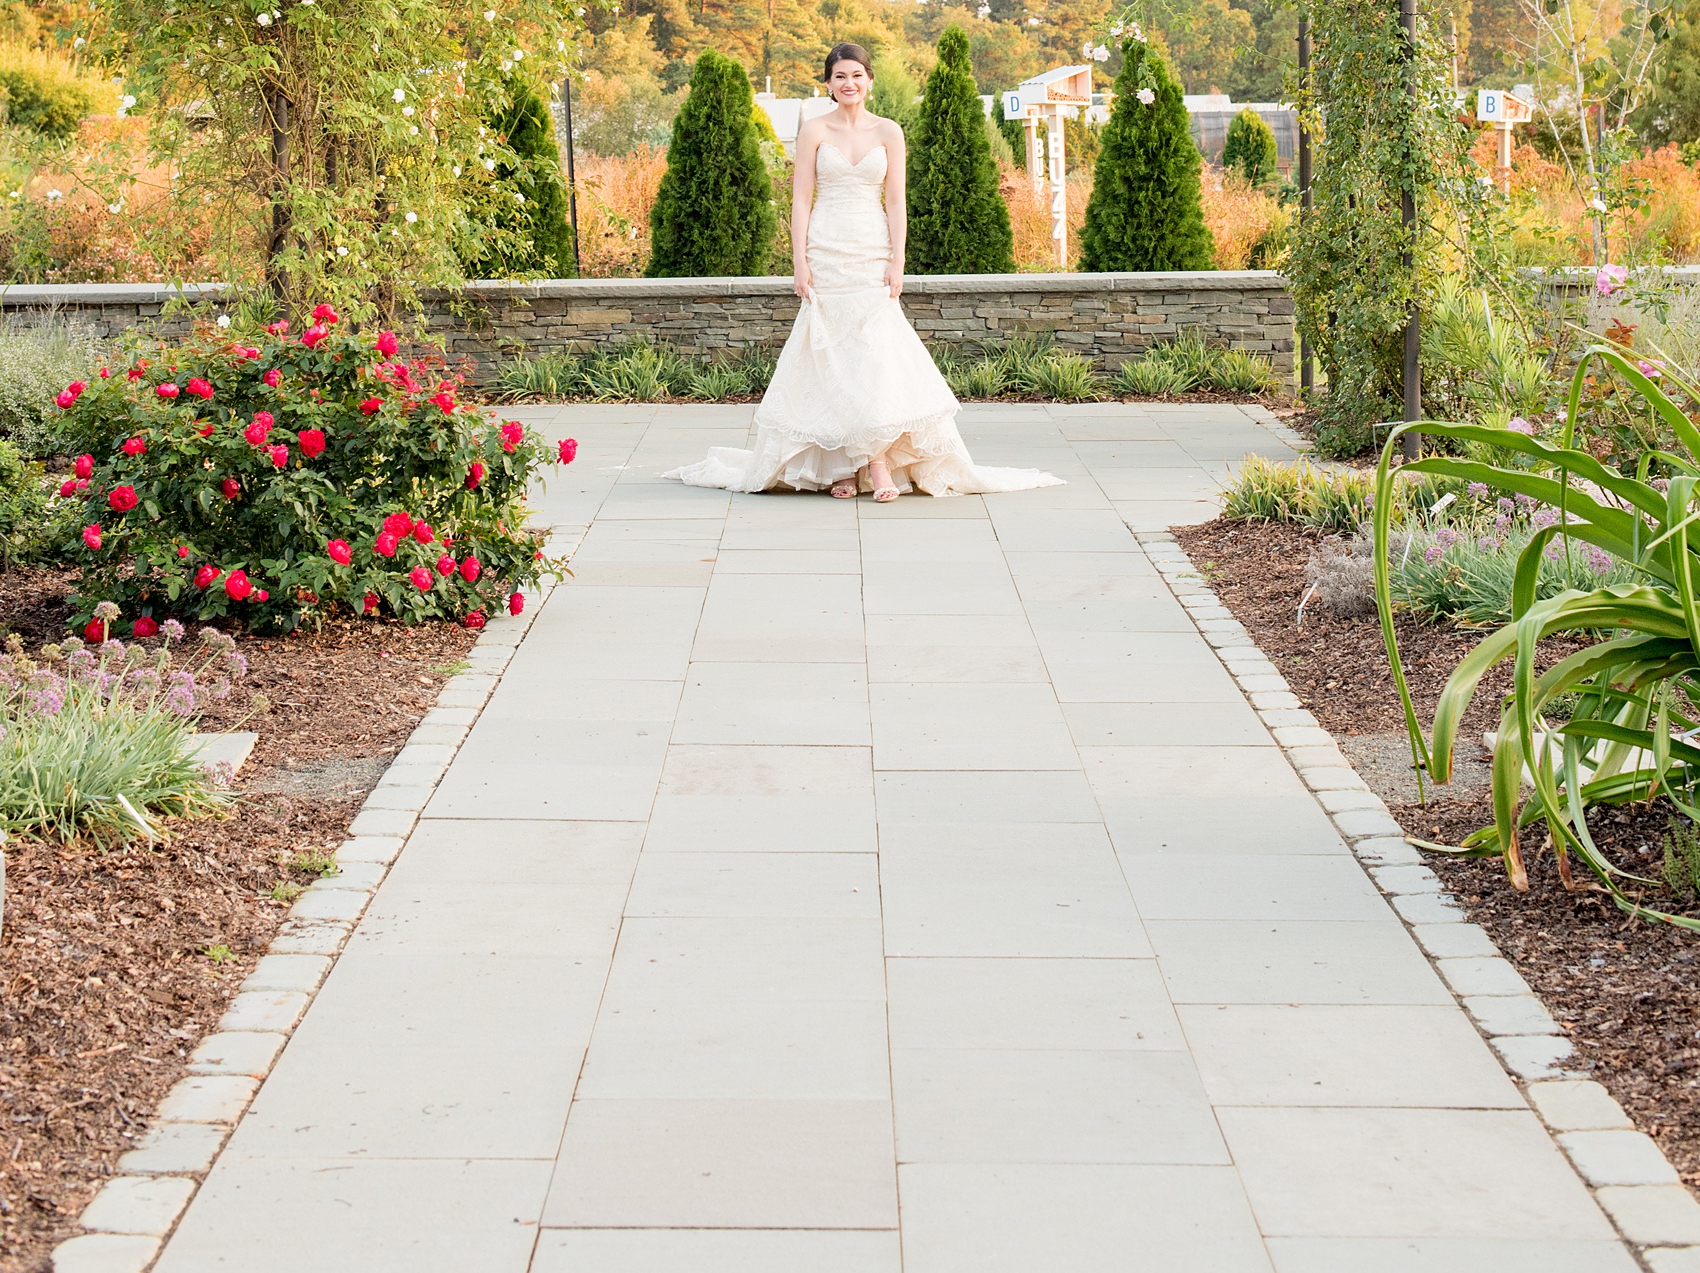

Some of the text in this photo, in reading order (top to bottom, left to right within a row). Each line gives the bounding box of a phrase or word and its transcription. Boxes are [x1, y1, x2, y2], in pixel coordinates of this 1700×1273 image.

[1010, 96, 1020, 112] D
[1486, 96, 1496, 113] B
[1049, 132, 1066, 239] BUZZ
